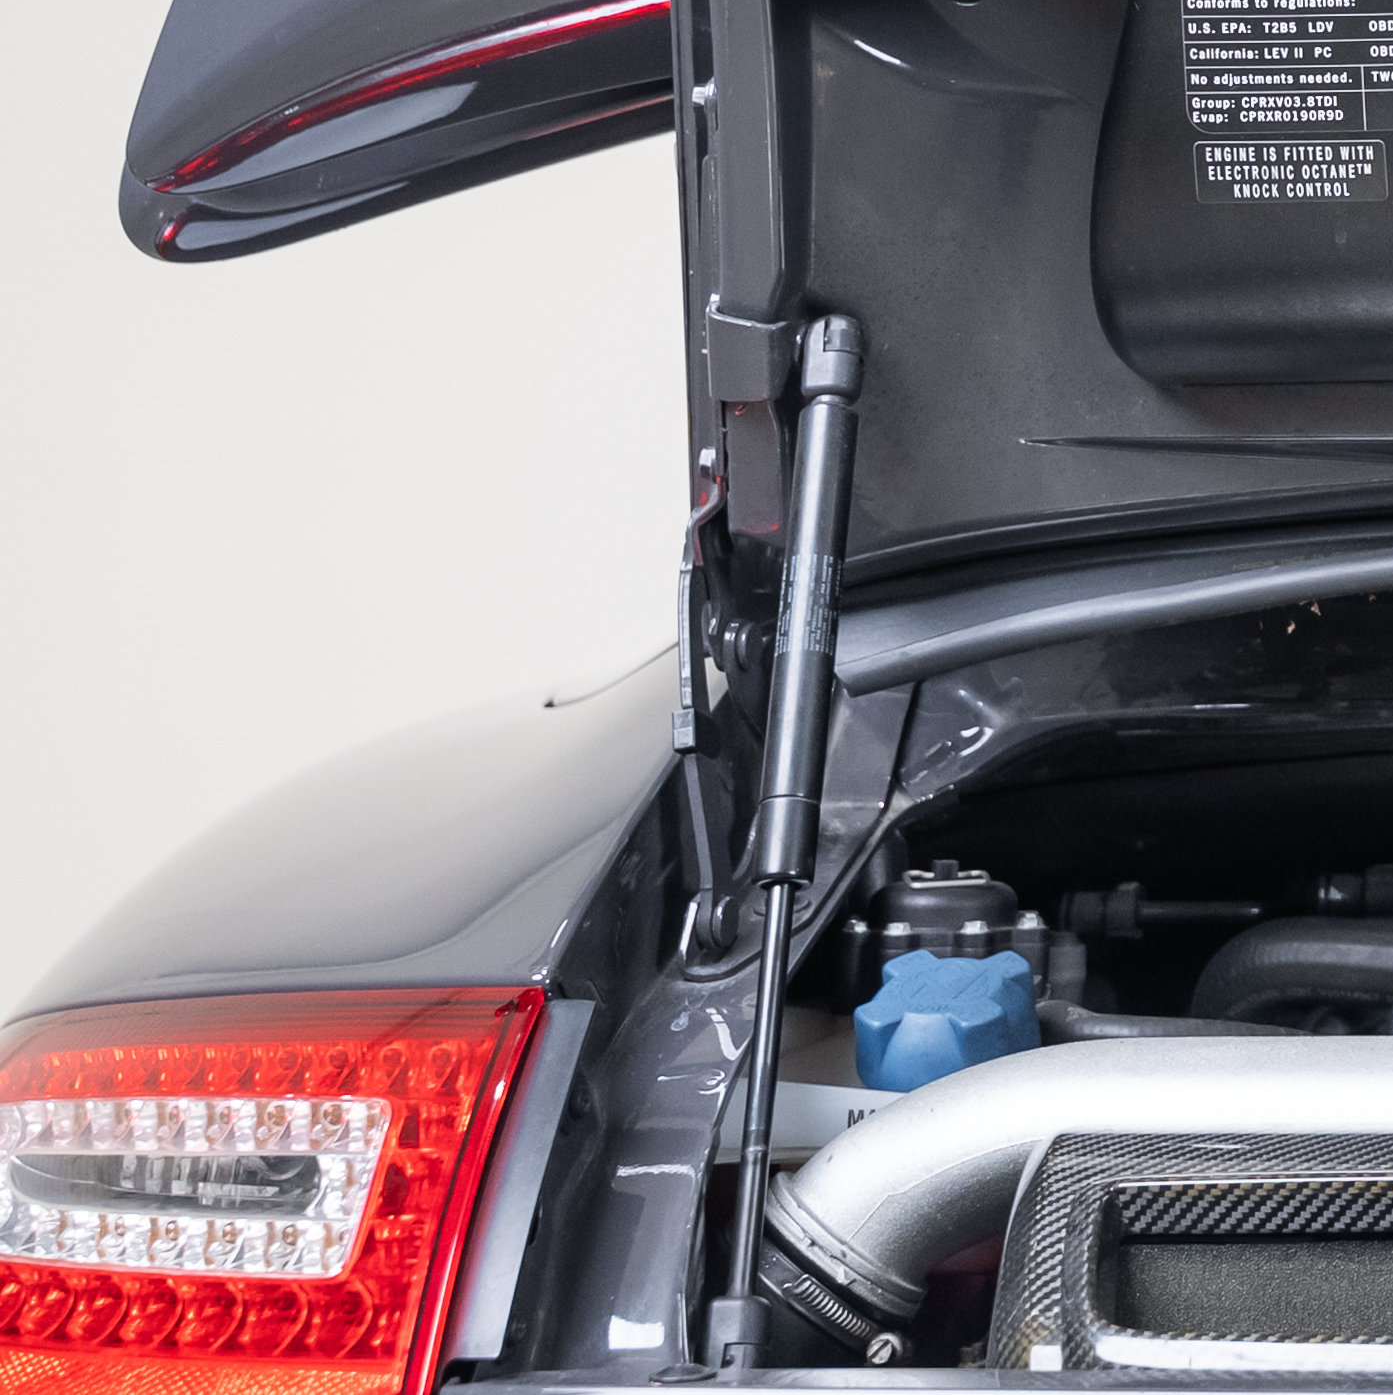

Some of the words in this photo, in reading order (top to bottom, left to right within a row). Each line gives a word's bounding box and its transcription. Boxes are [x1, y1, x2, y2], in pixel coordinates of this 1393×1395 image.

[1188, 23, 1216, 34] U.S.
[1221, 22, 1252, 34] EPA:
[1263, 22, 1297, 34] T2B5
[1308, 21, 1334, 33] LDV
[1189, 47, 1260, 60] California:
[1264, 47, 1290, 59] LEV
[1294, 47, 1303, 59] II
[1314, 46, 1332, 58] PC
[1190, 73, 1208, 85] No
[1214, 72, 1295, 88] adjustments
[1300, 71, 1353, 84] needed.
[1191, 97, 1236, 111] Group:
[1192, 111, 1229, 125] Evap:
[1206, 147, 1256, 162] ENGINE
[1263, 147, 1278, 161] IS
[1284, 146, 1333, 161] FITTED
[1340, 145, 1374, 160] WITH
[1208, 165, 1295, 180] ELECTRONIC
[1233, 184, 1280, 199] KNOCK
[1286, 182, 1350, 197] CONTROL
